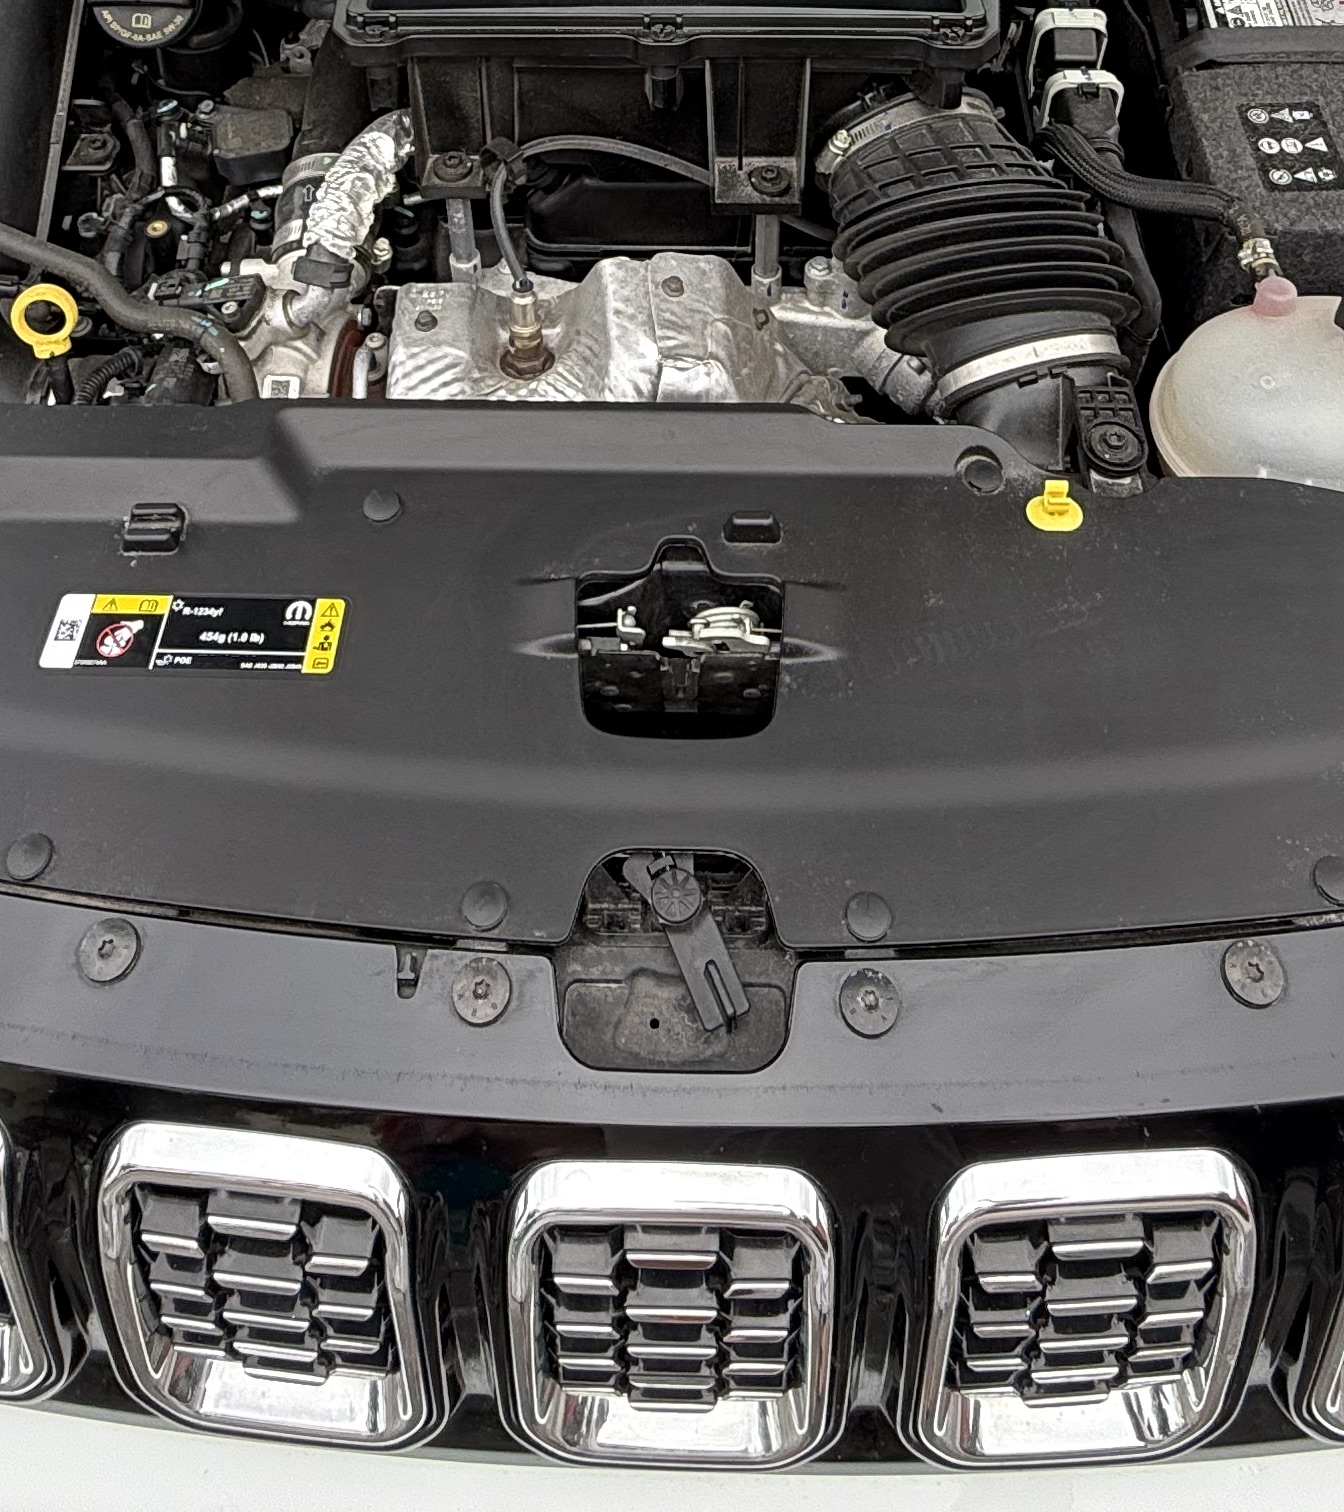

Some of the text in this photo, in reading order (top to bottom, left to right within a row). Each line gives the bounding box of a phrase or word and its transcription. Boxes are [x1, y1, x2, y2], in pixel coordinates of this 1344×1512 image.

[199, 631, 265, 645] 454g (1.0 lb)
